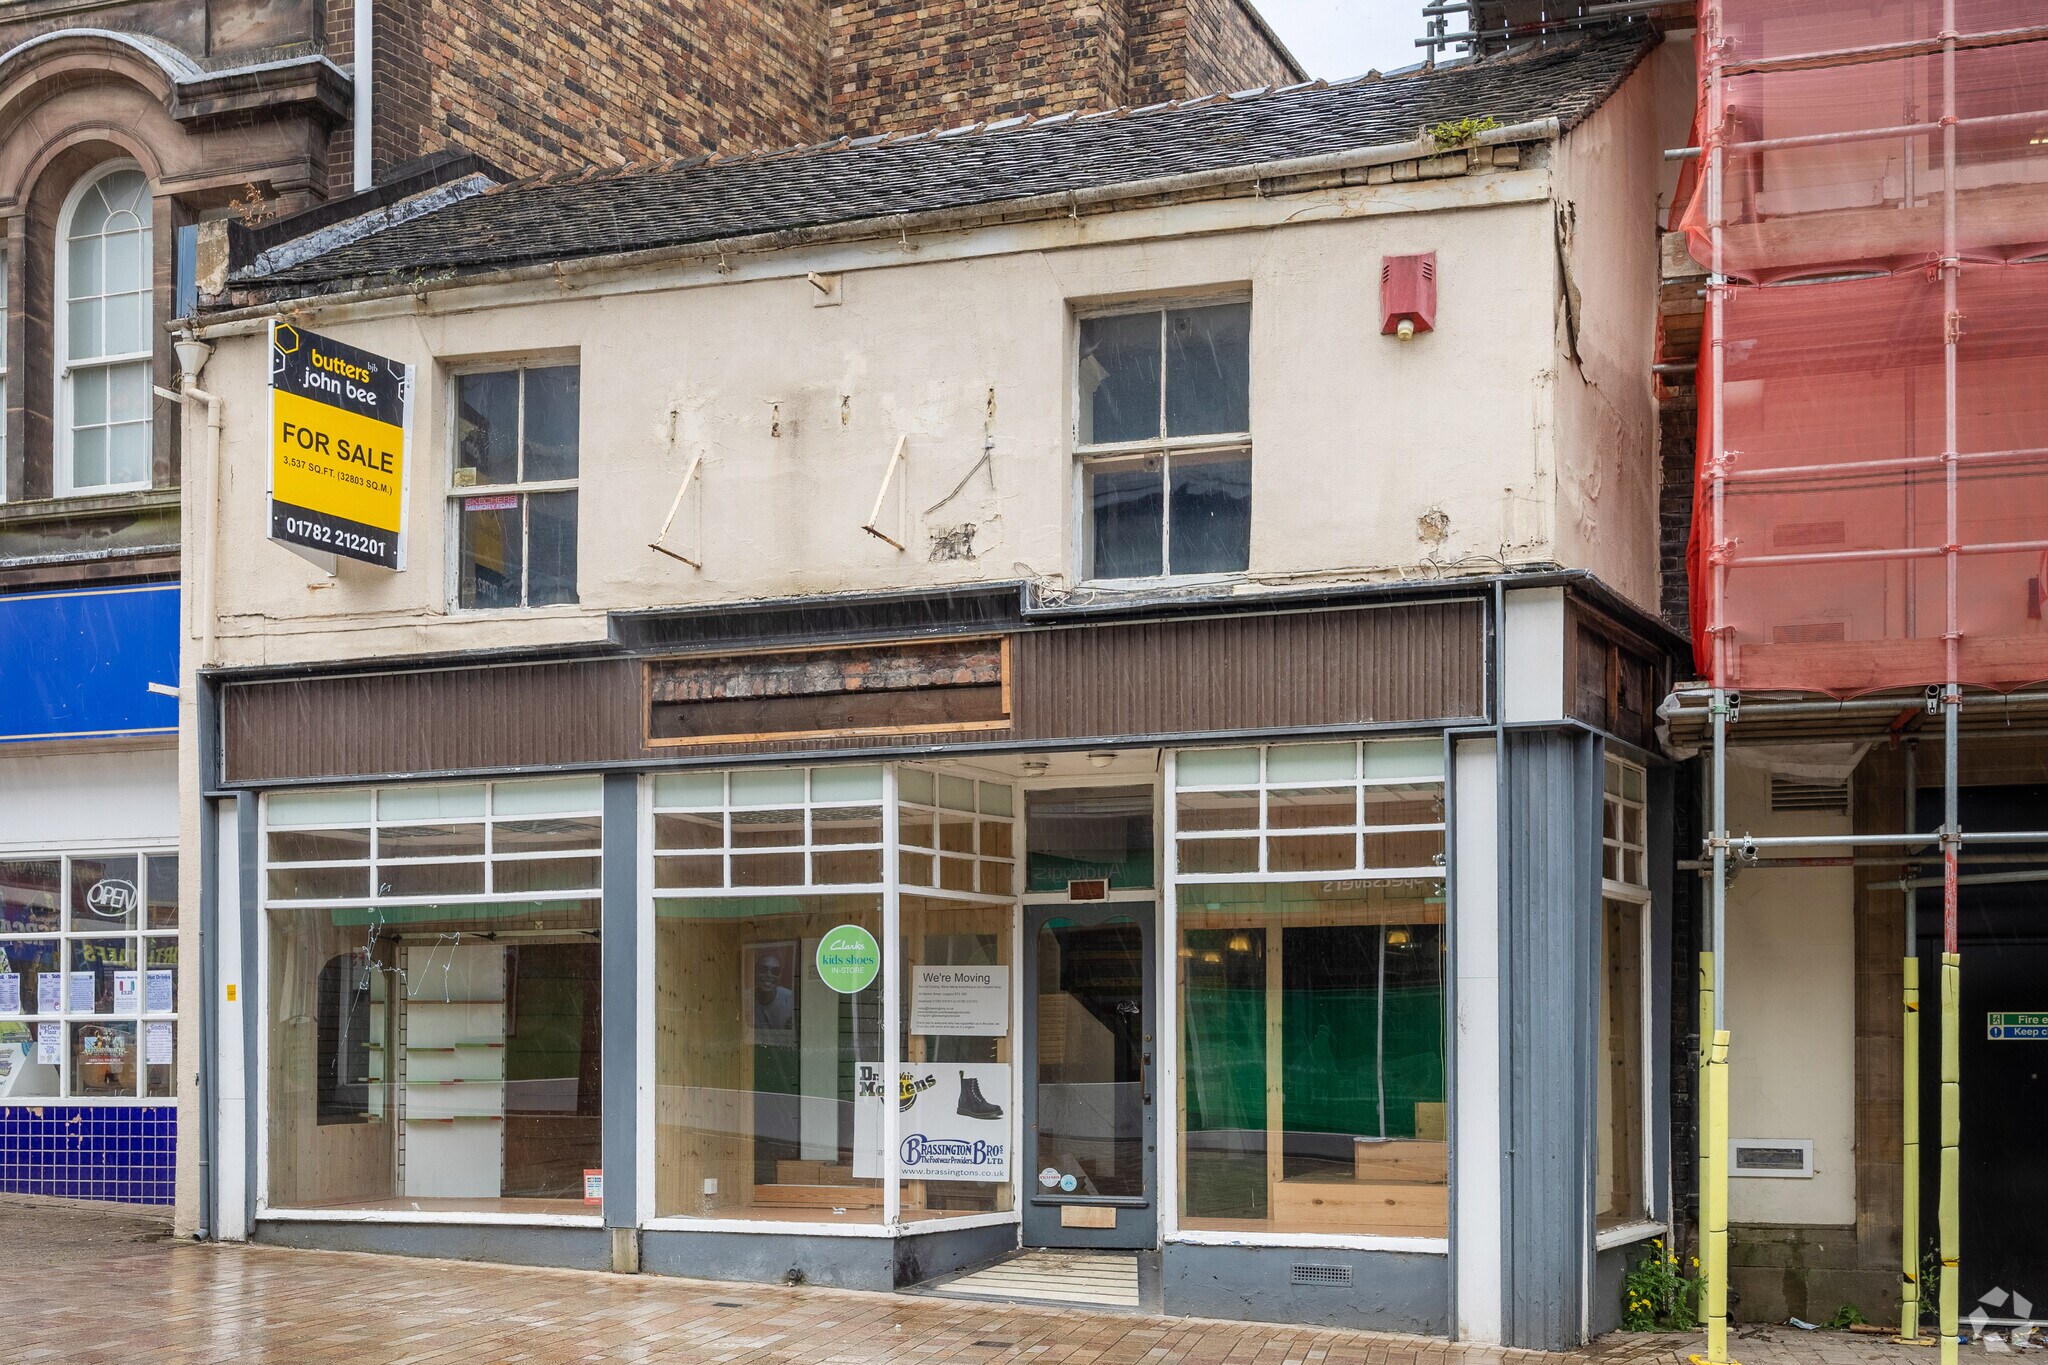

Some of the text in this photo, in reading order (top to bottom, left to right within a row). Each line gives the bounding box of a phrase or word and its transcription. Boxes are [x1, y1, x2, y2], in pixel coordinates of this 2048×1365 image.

[311, 348, 370, 384] butters
[367, 361, 378, 373] bjb
[302, 366, 377, 406] john bee
[283, 421, 394, 475] FOR SALE
[283, 455, 306, 469] 3,537
[308, 462, 336, 478] SQ.FT.
[366, 479, 393, 496] SQ.M.)
[465, 495, 518, 506] SKECHERS
[286, 517, 386, 557] 01782 212201
[89, 884, 133, 910] OPEN
[830, 939, 865, 950] Clarks
[822, 954, 874, 965] kids shoes
[831, 966, 865, 974] IN-STORE
[922, 972, 991, 985] We're Moving
[2018, 1015, 2048, 1024] Fire e
[2014, 1027, 2039, 1037] Keep
[859, 1065, 880, 1081] Dr.
[900, 1134, 973, 1166] BRASSINGTON
[921, 1155, 930, 1164] The
[930, 1155, 951, 1164] Footwear
[901, 1167, 1005, 1178] www.brassingtons.co.uk
